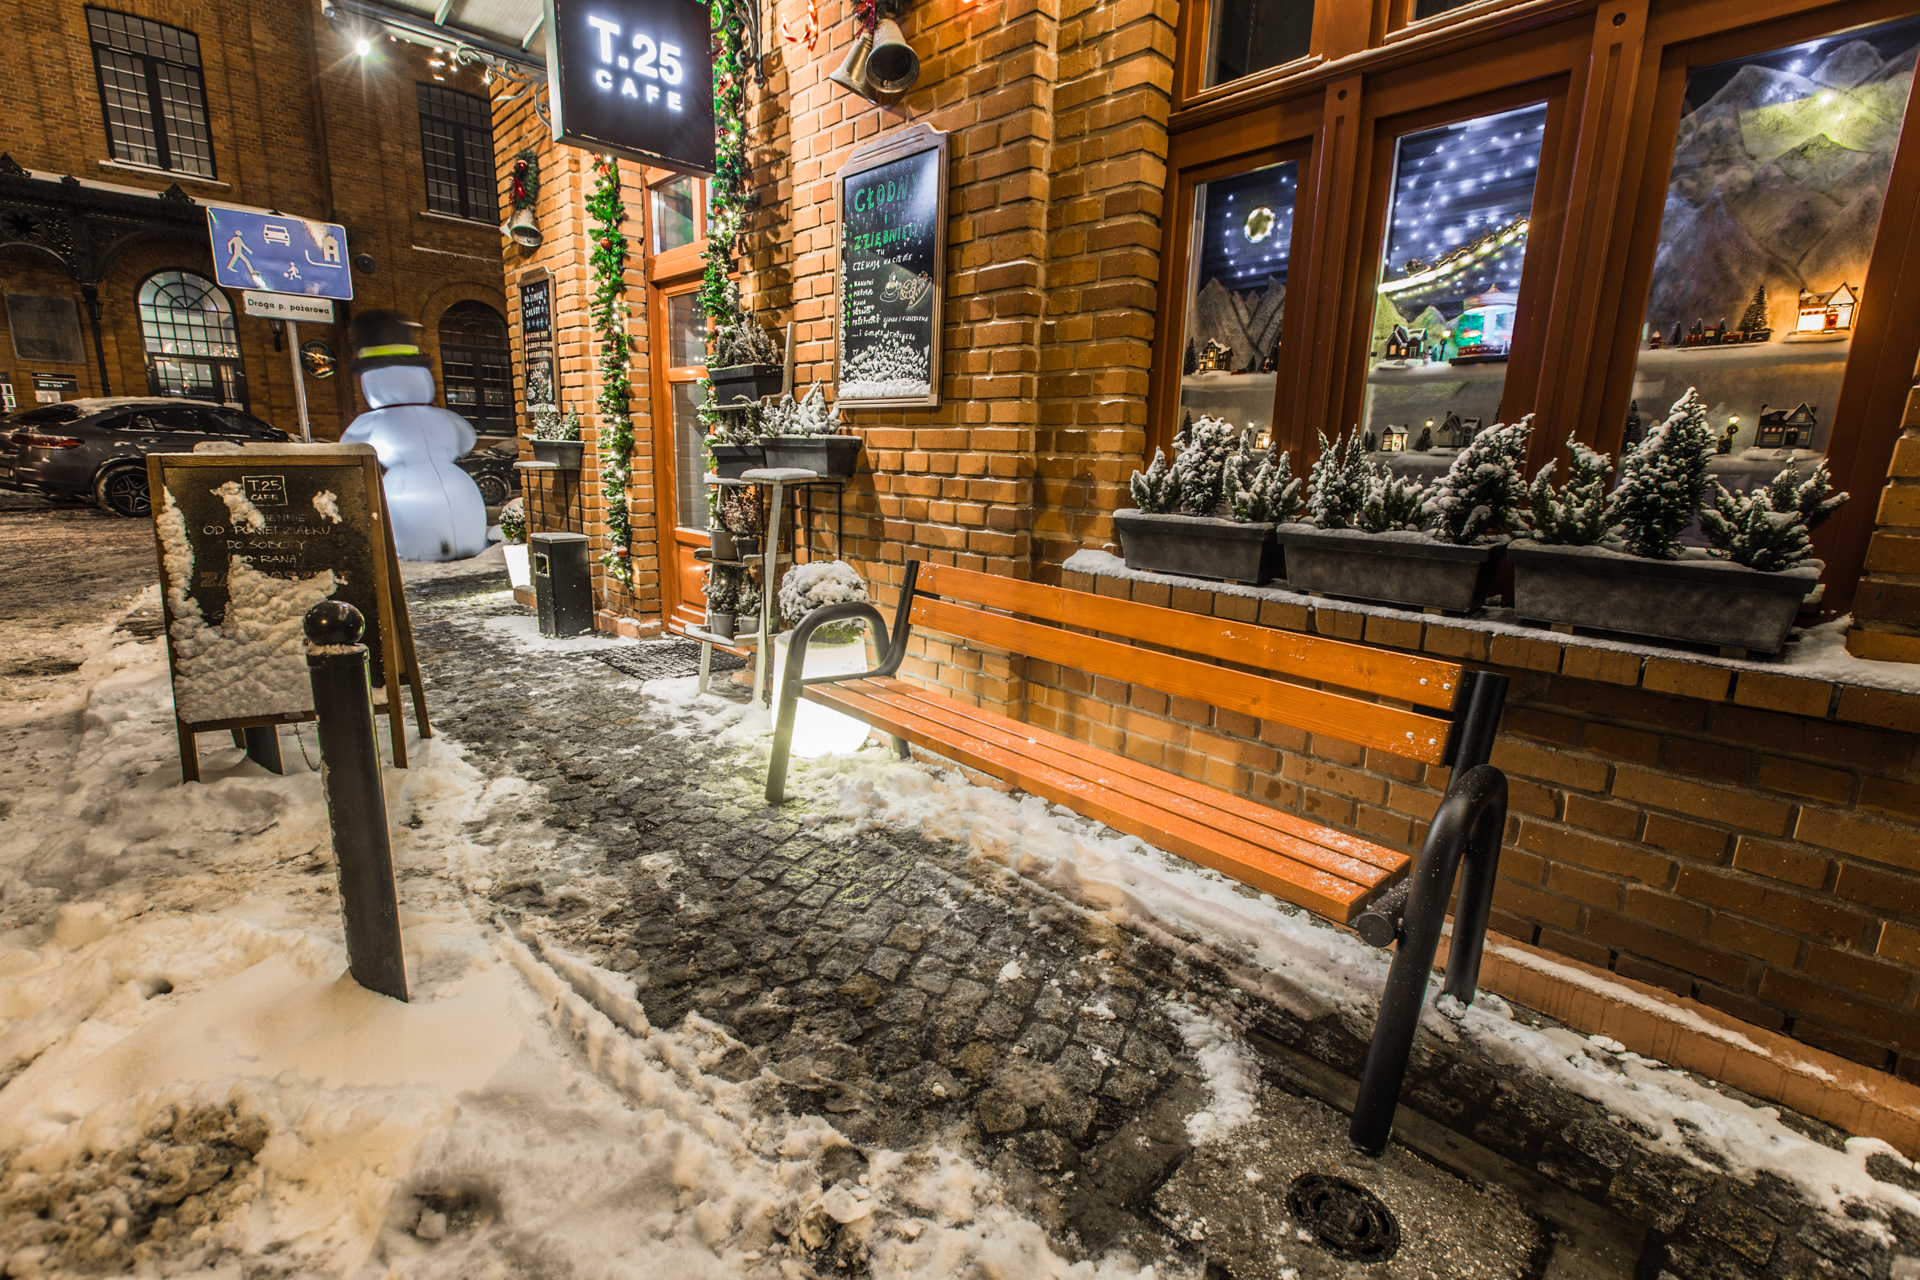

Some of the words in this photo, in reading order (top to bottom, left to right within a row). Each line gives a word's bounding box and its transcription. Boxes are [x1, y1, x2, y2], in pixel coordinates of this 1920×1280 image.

[588, 15, 683, 85] T.25
[595, 69, 682, 111] CAFE
[247, 298, 275, 309] Droga
[278, 303, 287, 311] p.
[289, 303, 330, 314] pożarowa
[247, 480, 282, 491] T.25
[203, 525, 225, 535] OD
[227, 540, 244, 549] DO
